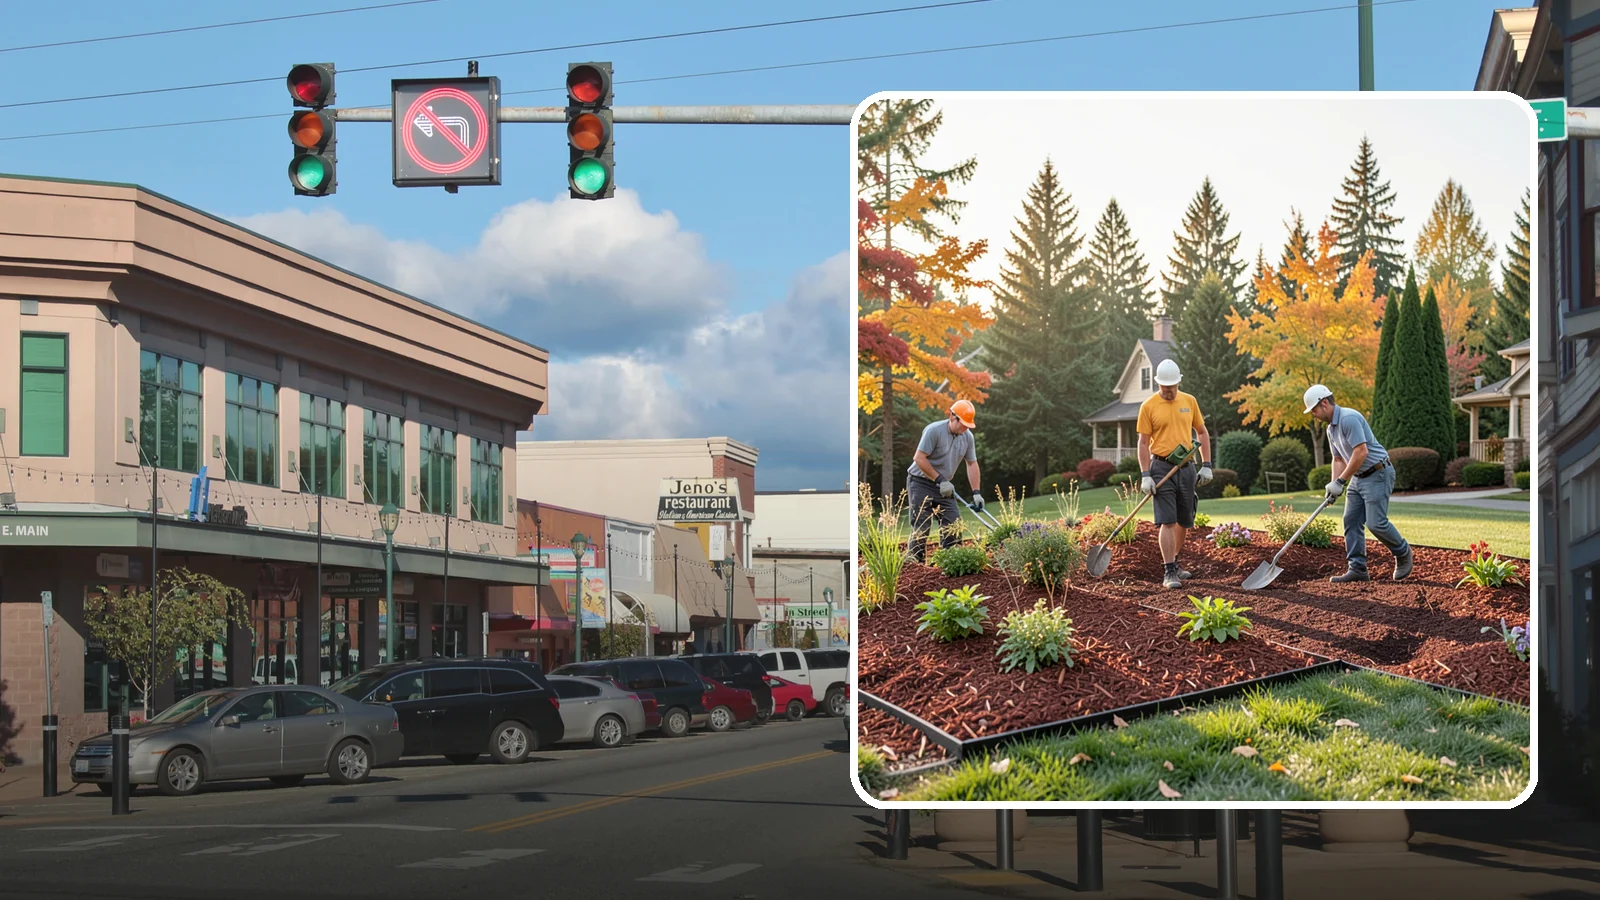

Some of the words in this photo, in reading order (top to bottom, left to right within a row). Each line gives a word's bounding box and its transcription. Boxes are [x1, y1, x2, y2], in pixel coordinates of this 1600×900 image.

[669, 480, 727, 495] Jeno's
[665, 496, 731, 509] restaurant
[658, 509, 681, 519] Italian
[686, 509, 715, 519] American
[715, 509, 738, 519] Cuisine
[2, 525, 13, 536] E.
[15, 525, 49, 536] MAIN
[797, 607, 829, 617] Street
